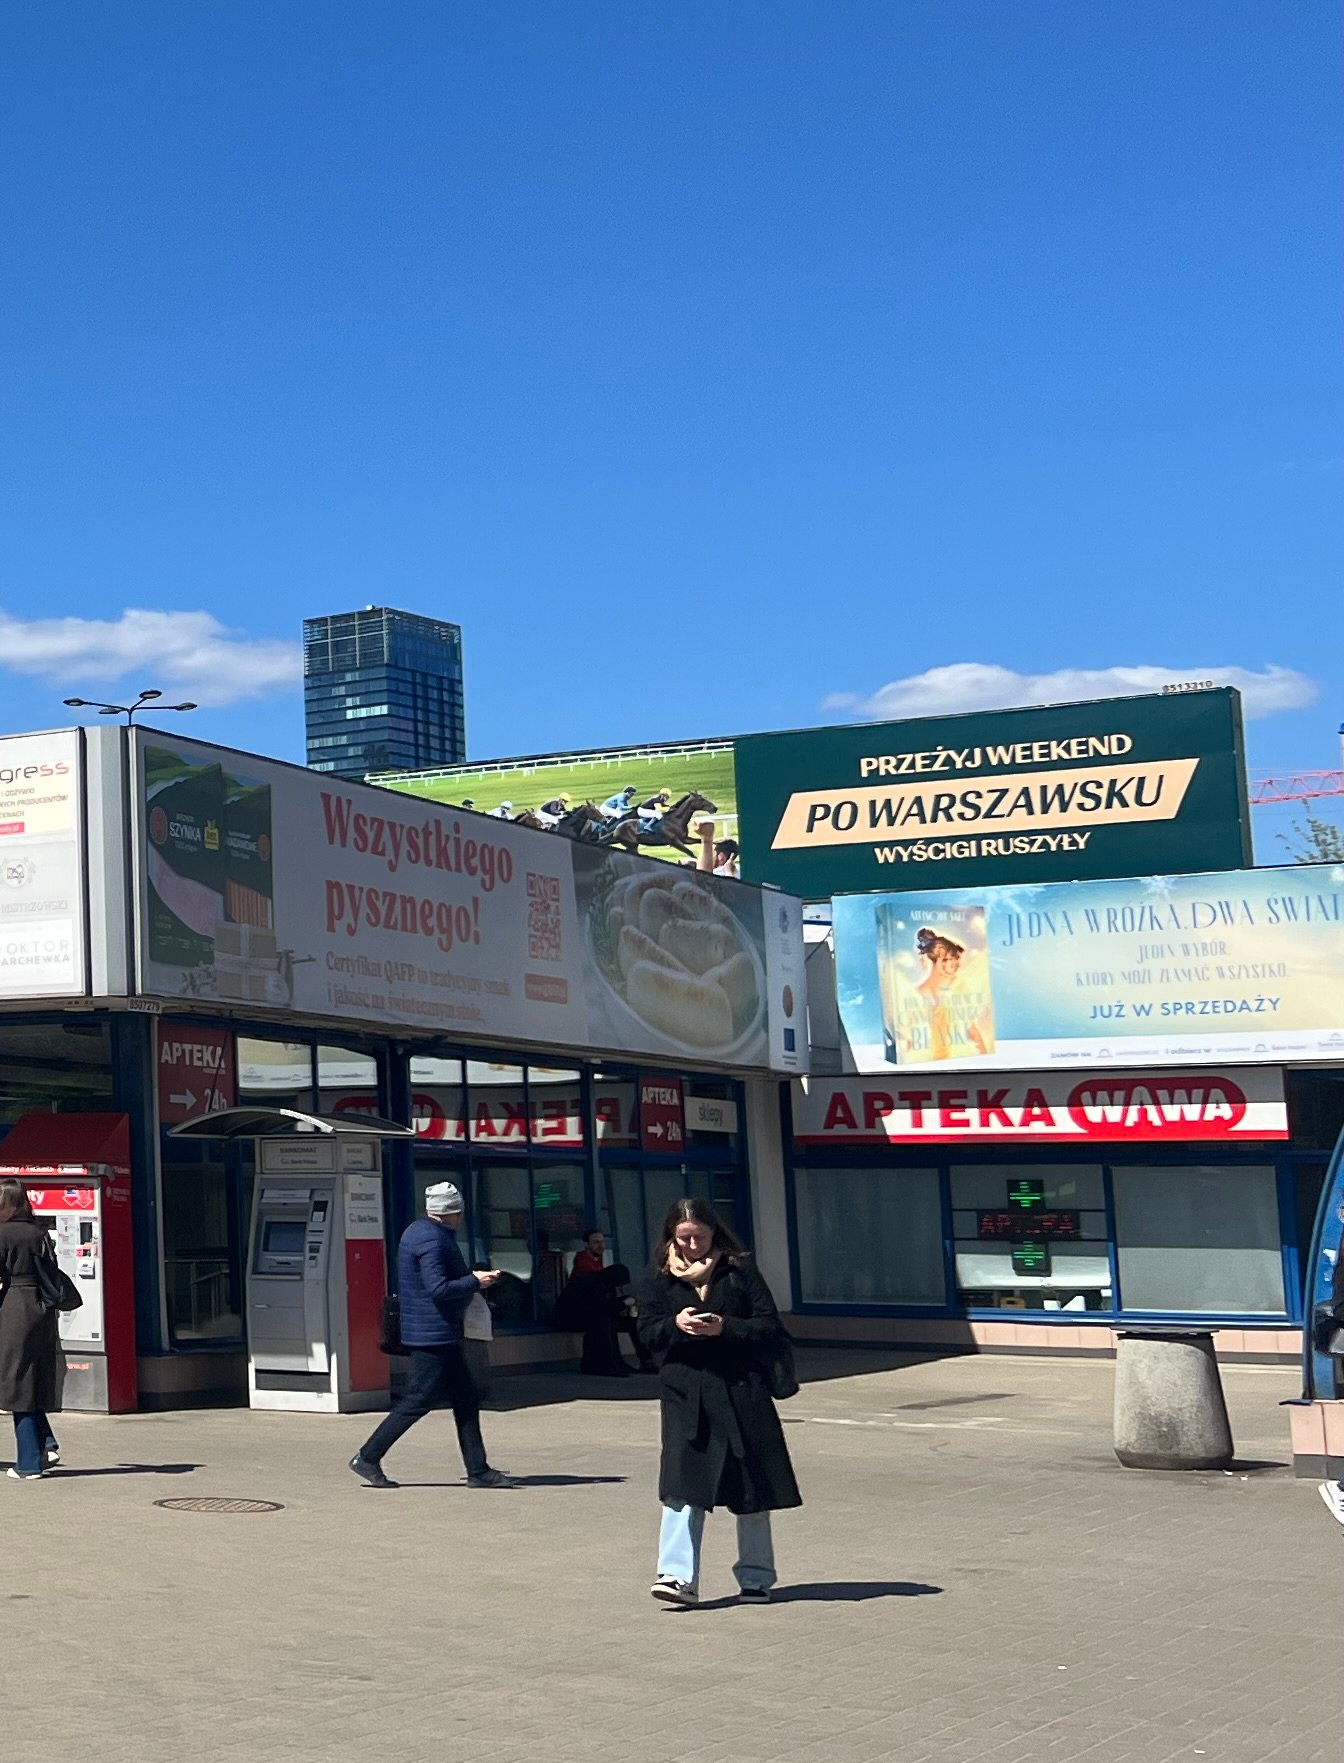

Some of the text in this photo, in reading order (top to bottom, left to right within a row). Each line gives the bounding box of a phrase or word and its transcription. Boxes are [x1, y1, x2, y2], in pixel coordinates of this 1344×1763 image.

[859, 733, 1133, 778] PRZEŻYJ WEEKEND
[805, 774, 1166, 834] PO WARSZAWSKU
[169, 821, 201, 842] SZYNKA
[319, 791, 513, 892] Wszystkiego
[873, 832, 1093, 864] WYŚCIGI RUSZYŁY
[324, 879, 481, 953] pysznego!
[1002, 909, 1075, 948] JEDNA
[1191, 899, 1255, 931] DWA
[325, 950, 382, 979] Certyfikat
[384, 959, 416, 985] QAFP
[1136, 943, 1176, 964] JEDEN
[1089, 994, 1282, 1020] JUŻ W SPRZEDAŻY
[160, 1041, 226, 1069] APTEKA
[204, 1087, 228, 1114] 24h
[641, 1086, 680, 1106] APTEKA
[822, 1084, 1235, 1131] APTEKA WAWA
[666, 1120, 682, 1141] 24h
